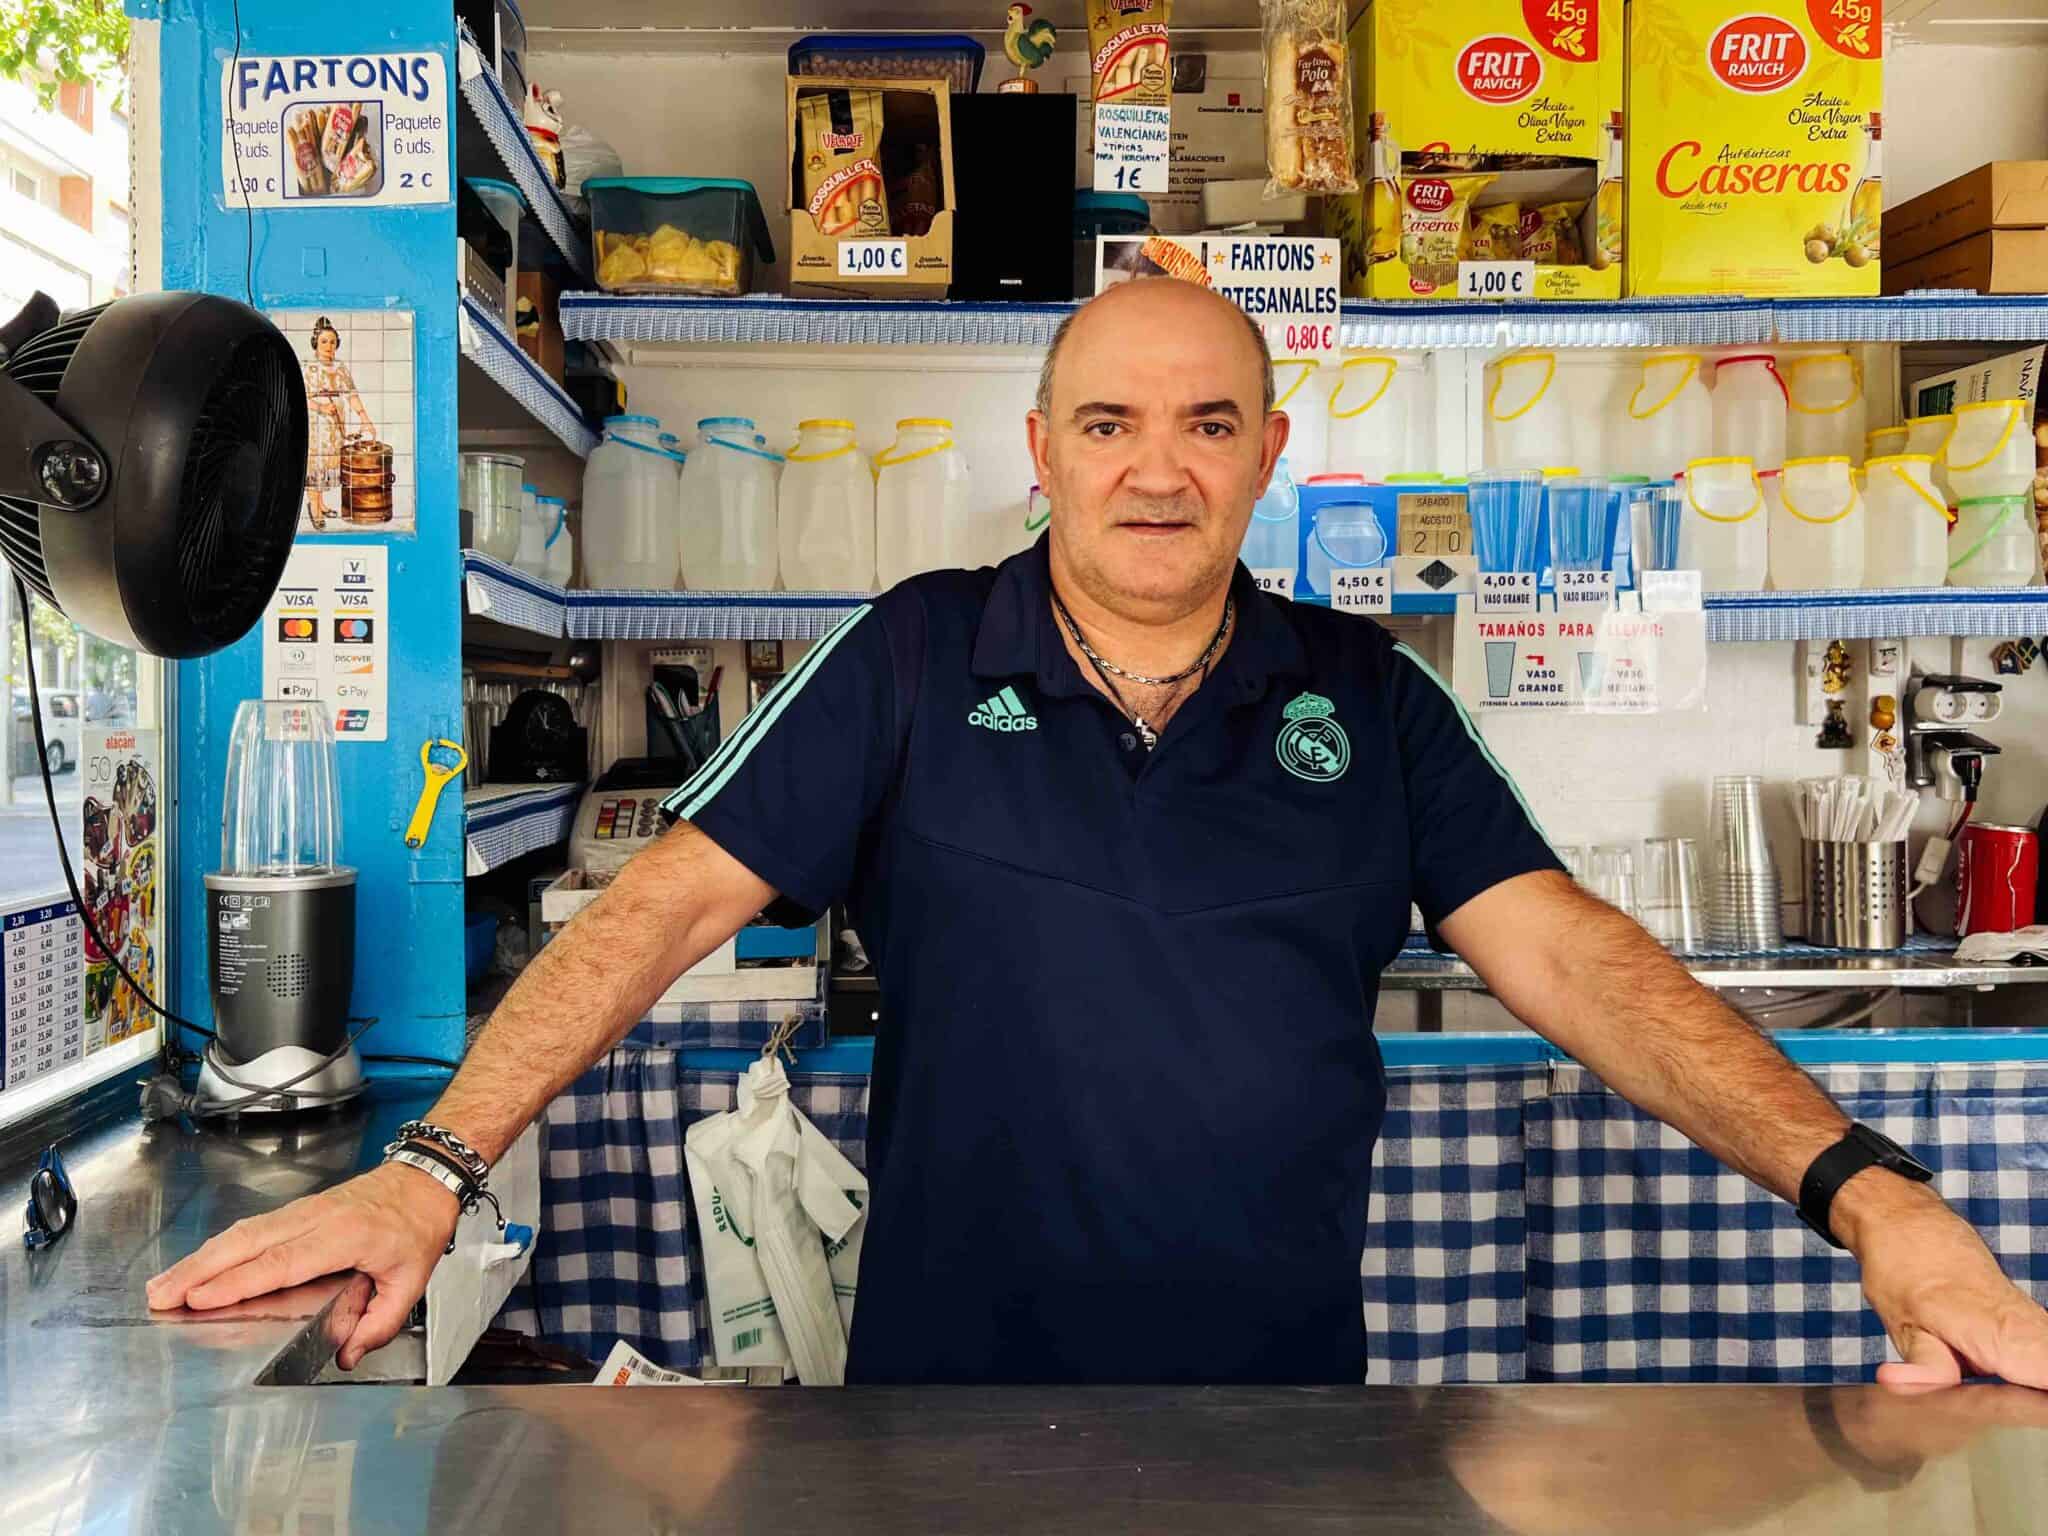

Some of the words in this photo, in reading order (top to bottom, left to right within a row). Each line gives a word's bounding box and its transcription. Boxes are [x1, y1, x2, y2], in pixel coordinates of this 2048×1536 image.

[1547, 0, 1587, 24] 45g
[1830, 0, 1872, 22] 45g
[1721, 32, 1794, 61] FRIT
[1466, 51, 1532, 77] FRIT
[1727, 63, 1785, 77] RAVICH
[1301, 67, 1329, 82] Polo
[238, 57, 429, 111] FARTONS
[1473, 77, 1523, 91] RAVICH
[1098, 107, 1170, 125] ROSQUILLETAS
[1517, 112, 1548, 128] Oliva
[1548, 112, 1586, 129] Virgen
[1788, 108, 1822, 125] Oliva
[1823, 107, 1862, 126] Virgen
[225, 117, 279, 137] Paquete
[385, 113, 442, 136] Paquete
[1097, 124, 1168, 142] VALENCIANAS
[1808, 125, 1848, 142] Extra
[1535, 127, 1574, 144] Extra
[245, 142, 272, 158] uds.
[394, 138, 403, 154] 6
[406, 138, 435, 155] uds.
[1655, 140, 1851, 199] Caseras
[400, 173, 413, 189] 2
[1412, 183, 1449, 199] FRIT
[847, 247, 885, 272] 1,00
[891, 247, 902, 268] €
[1231, 244, 1315, 271] FARTONS
[1469, 271, 1506, 295] 1,00
[1512, 271, 1522, 292] €
[1211, 287, 1336, 314] RTESANALES
[1286, 325, 1318, 354] 0,80
[1322, 325, 1332, 350] €
[1414, 531, 1427, 553] 2
[1448, 531, 1460, 553] 0
[350, 561, 359, 572] V
[1278, 578, 1288, 589] €
[1337, 576, 1369, 589] 4,50
[1375, 576, 1384, 587] €
[1484, 575, 1516, 588] 4,00
[1522, 575, 1530, 586] €
[1563, 573, 1594, 586] 3,20
[1601, 573, 1609, 583] €
[285, 595, 315, 606] VISA
[341, 594, 369, 606] VISA
[1338, 595, 1350, 605] 1/2
[1355, 594, 1384, 605] LITRO
[1484, 593, 1501, 604] VASO
[1503, 593, 1530, 604] GRANDE
[1563, 591, 1579, 601] VASO
[1581, 591, 1609, 601] MEDIANO
[1478, 620, 1545, 637] TAMAÑOS
[1559, 623, 1594, 637] PARA
[335, 655, 371, 663] DISCOVER
[1527, 670, 1556, 678] VASO
[292, 685, 313, 697] Pay
[350, 685, 369, 698] Pay
[1518, 684, 1564, 693] GRANDE
[967, 711, 1039, 732] adidas
[89, 756, 111, 782] 50
